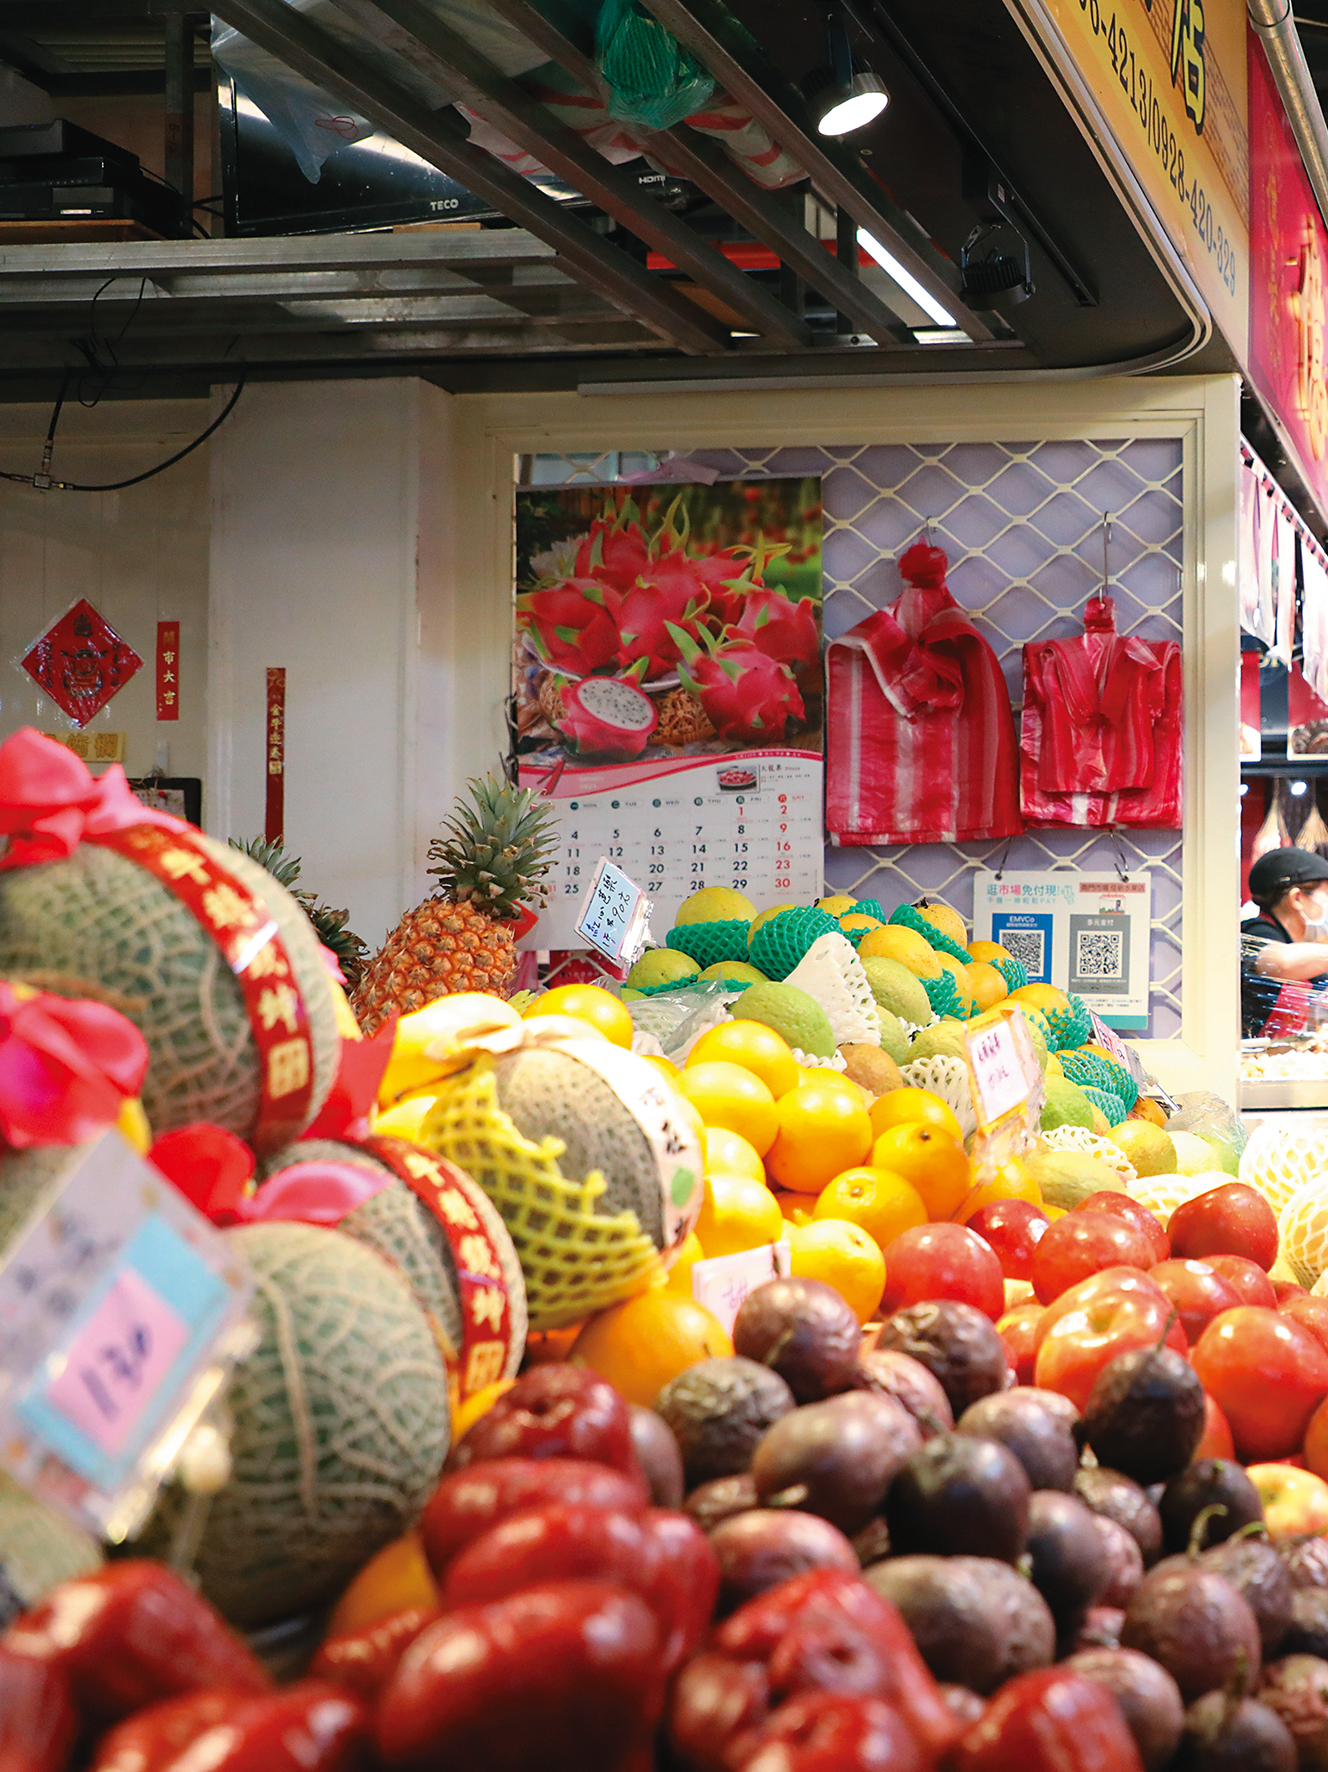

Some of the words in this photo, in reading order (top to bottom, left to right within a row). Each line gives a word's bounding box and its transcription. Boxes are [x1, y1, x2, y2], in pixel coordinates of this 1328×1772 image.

[1080, 0, 1237, 297] 6-4213/0928-420-329
[638, 174, 666, 184] HDMI
[430, 198, 459, 211] TECO
[739, 806, 744, 816] 1
[780, 805, 788, 815] 2
[571, 831, 579, 840] 4
[613, 829, 620, 839] 5
[654, 828, 662, 837] 6
[695, 826, 703, 836] 7
[738, 825, 745, 834] 8
[780, 823, 788, 833] 9
[568, 848, 580, 857] 11
[609, 847, 623, 856] 12
[651, 846, 665, 855] 13
[692, 844, 706, 854] 14
[734, 843, 748, 853] 15
[777, 842, 791, 851] 16
[567, 866, 580, 875] 18
[649, 864, 664, 873] 20
[691, 863, 704, 872] 21
[733, 861, 748, 871] 22
[775, 860, 790, 870] 23
[565, 884, 579, 894] 25
[648, 882, 663, 891] 27
[691, 881, 705, 891] 28
[732, 879, 748, 889] 29
[775, 878, 791, 888] 30
[1009, 915, 1036, 923] EMVCo
